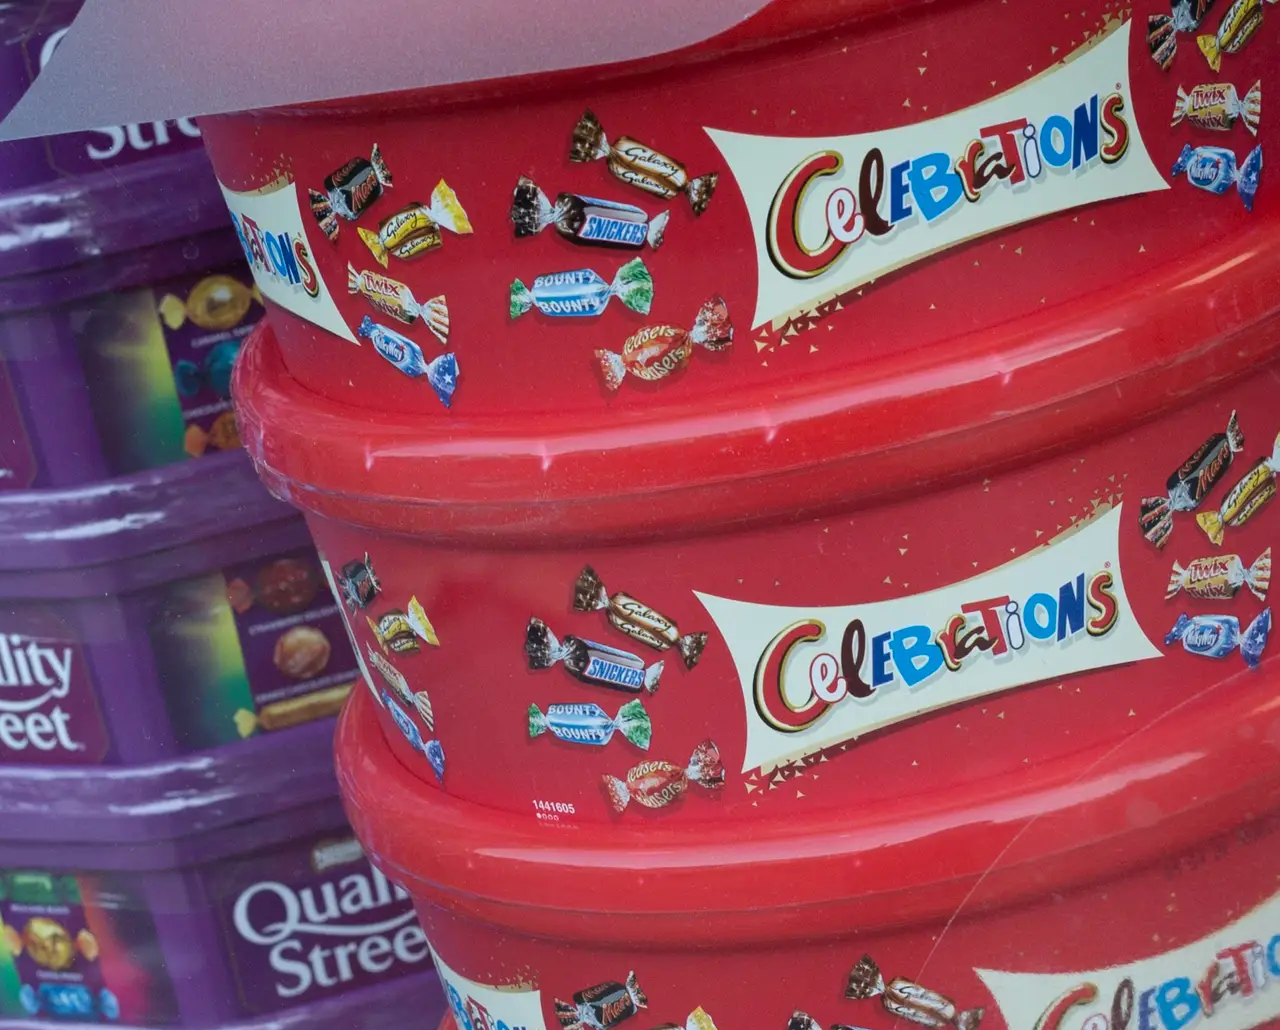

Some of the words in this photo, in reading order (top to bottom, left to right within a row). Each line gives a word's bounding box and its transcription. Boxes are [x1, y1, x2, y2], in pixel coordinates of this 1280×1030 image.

[624, 146, 680, 182] Galaxy
[351, 171, 377, 213] Mars
[621, 170, 670, 195] Galaxy
[385, 209, 420, 239] Galaxy
[582, 215, 648, 244] SNICKERS
[363, 272, 401, 297] Twix
[534, 270, 596, 289] BOUNTY
[539, 298, 598, 315] BOUNTY
[1195, 442, 1231, 500] Mars
[1190, 560, 1230, 582] Twix
[621, 602, 672, 632] Galaxy
[587, 658, 644, 687] SNICKERS
[547, 704, 601, 717] BOUNTY
[553, 726, 605, 741] BOUNTY
[532, 799, 576, 815] 1441605
[269, 922, 430, 999] Stree
[601, 993, 631, 1024] Mars
